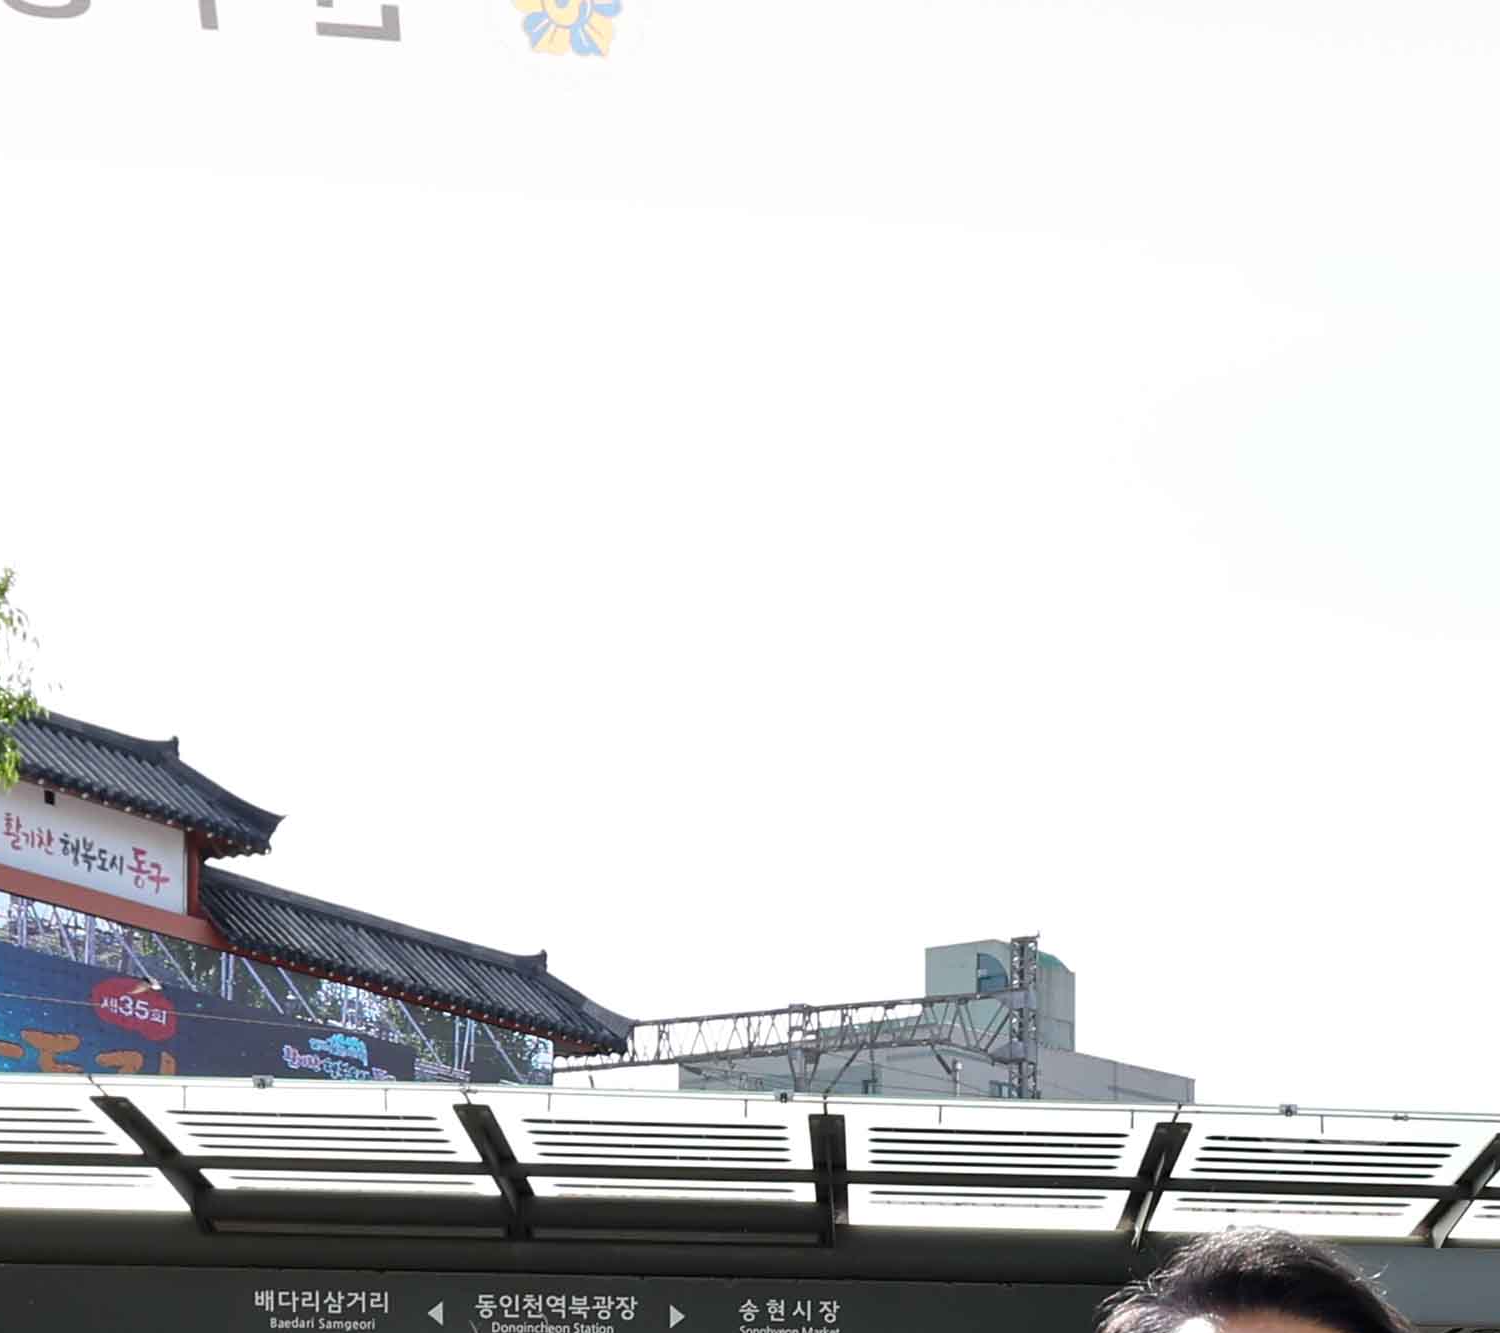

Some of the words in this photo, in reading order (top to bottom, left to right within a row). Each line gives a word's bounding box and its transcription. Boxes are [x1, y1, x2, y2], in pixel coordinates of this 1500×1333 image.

[3, 811, 54, 855] 활기찬
[59, 832, 125, 876] 행복도시
[127, 846, 170, 893] 동구
[100, 995, 167, 1025] 제35회
[254, 1289, 389, 1314] 배다리삼거리
[475, 1293, 639, 1321] 동인천역북광장
[738, 1298, 841, 1324] 송현시장
[270, 1316, 315, 1330] Baedari
[318, 1318, 376, 1331] Samgeori
[491, 1321, 571, 1333] Dongincheon
